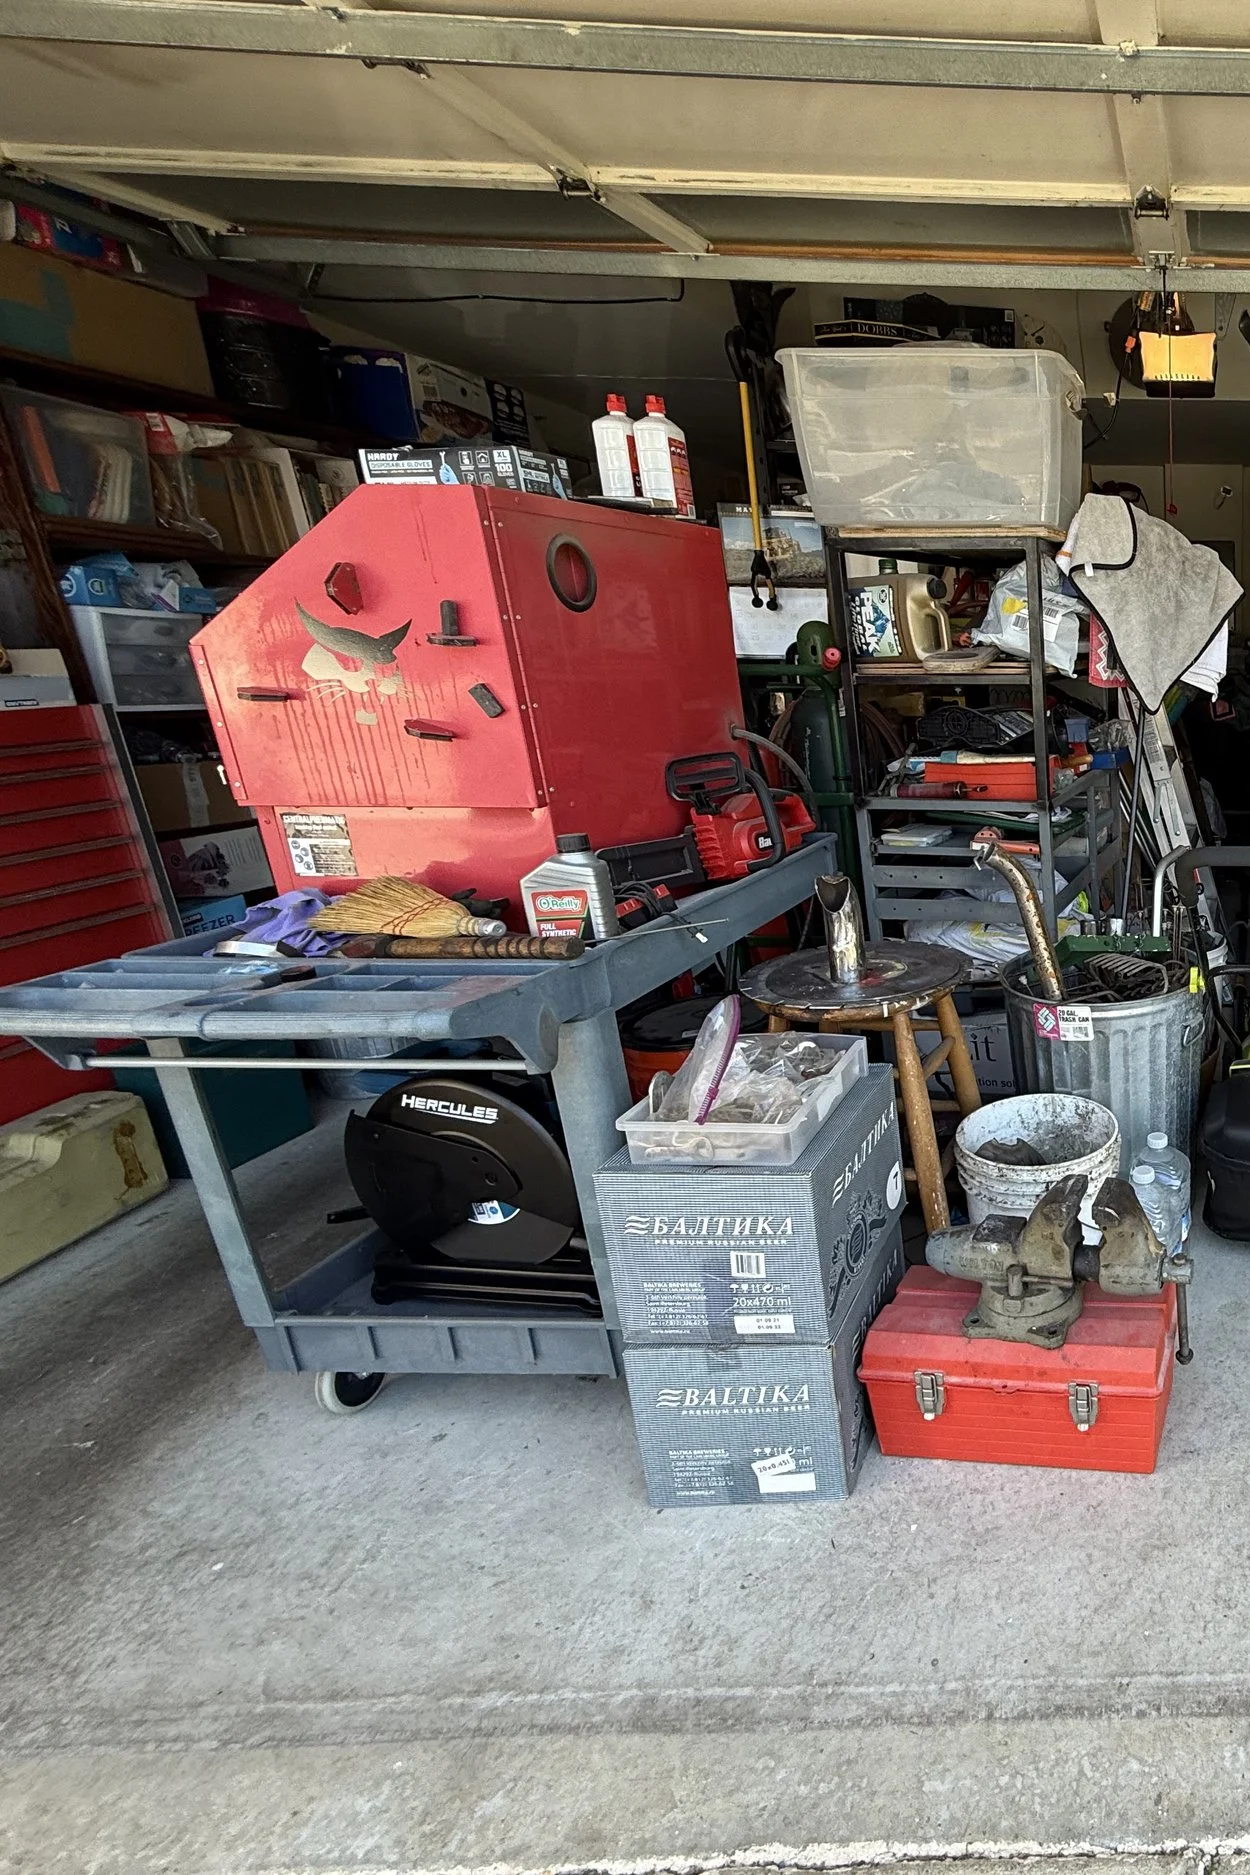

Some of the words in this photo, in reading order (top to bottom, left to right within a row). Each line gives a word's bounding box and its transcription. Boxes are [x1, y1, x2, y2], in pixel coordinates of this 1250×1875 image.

[858, 323, 898, 336] DOBBS
[368, 452, 399, 462] HARDY
[372, 460, 405, 469] DISPOSABLE
[496, 463, 512, 472] 100
[860, 592, 881, 654] PEAK
[539, 896, 579, 909] O'Reilly
[185, 914, 236, 936] REEZER
[970, 1033, 996, 1062] it
[978, 1076, 998, 1088] tion
[1001, 1077, 1016, 1088] sol
[401, 1094, 498, 1120] HERCULES
[844, 1101, 896, 1192] БАЛТИКА
[652, 1216, 793, 1236] БАЛТИКА
[732, 1297, 774, 1307] 20x470
[777, 1296, 791, 1306] ml
[683, 1384, 810, 1407] BALTIKA
[799, 1457, 813, 1466] ml
